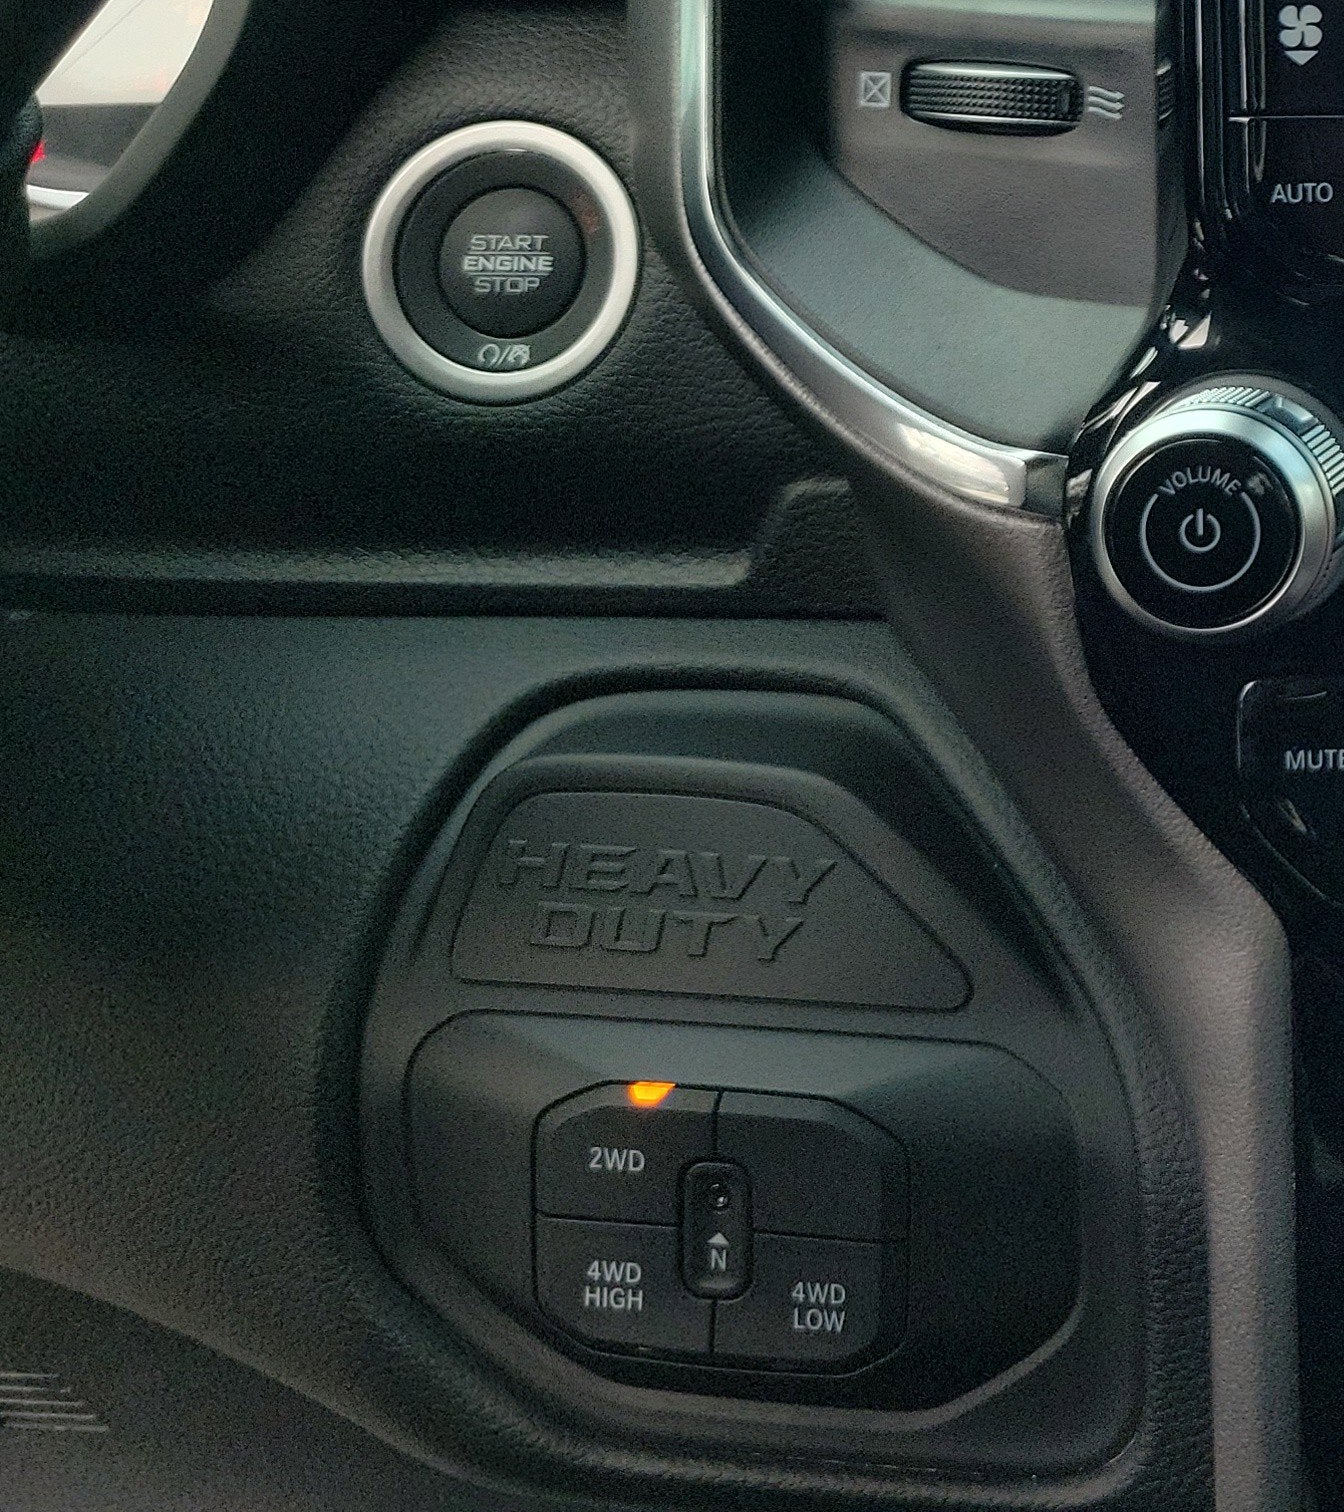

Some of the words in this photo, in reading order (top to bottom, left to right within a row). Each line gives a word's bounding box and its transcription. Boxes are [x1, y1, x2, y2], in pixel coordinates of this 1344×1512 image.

[1270, 183, 1333, 204] AUTO
[470, 235, 549, 250] START
[463, 256, 554, 271] ENGINE
[475, 277, 540, 293] STOP
[1158, 466, 1242, 497] VOLUME
[498, 838, 838, 906] HEAVY
[528, 900, 806, 964] DUTY
[588, 1146, 646, 1172] 2WD
[711, 1248, 727, 1271] N
[586, 1261, 643, 1285] 4WD
[584, 1286, 644, 1311] HIGH
[791, 1282, 846, 1306] 4WD
[793, 1308, 846, 1333] LOW
